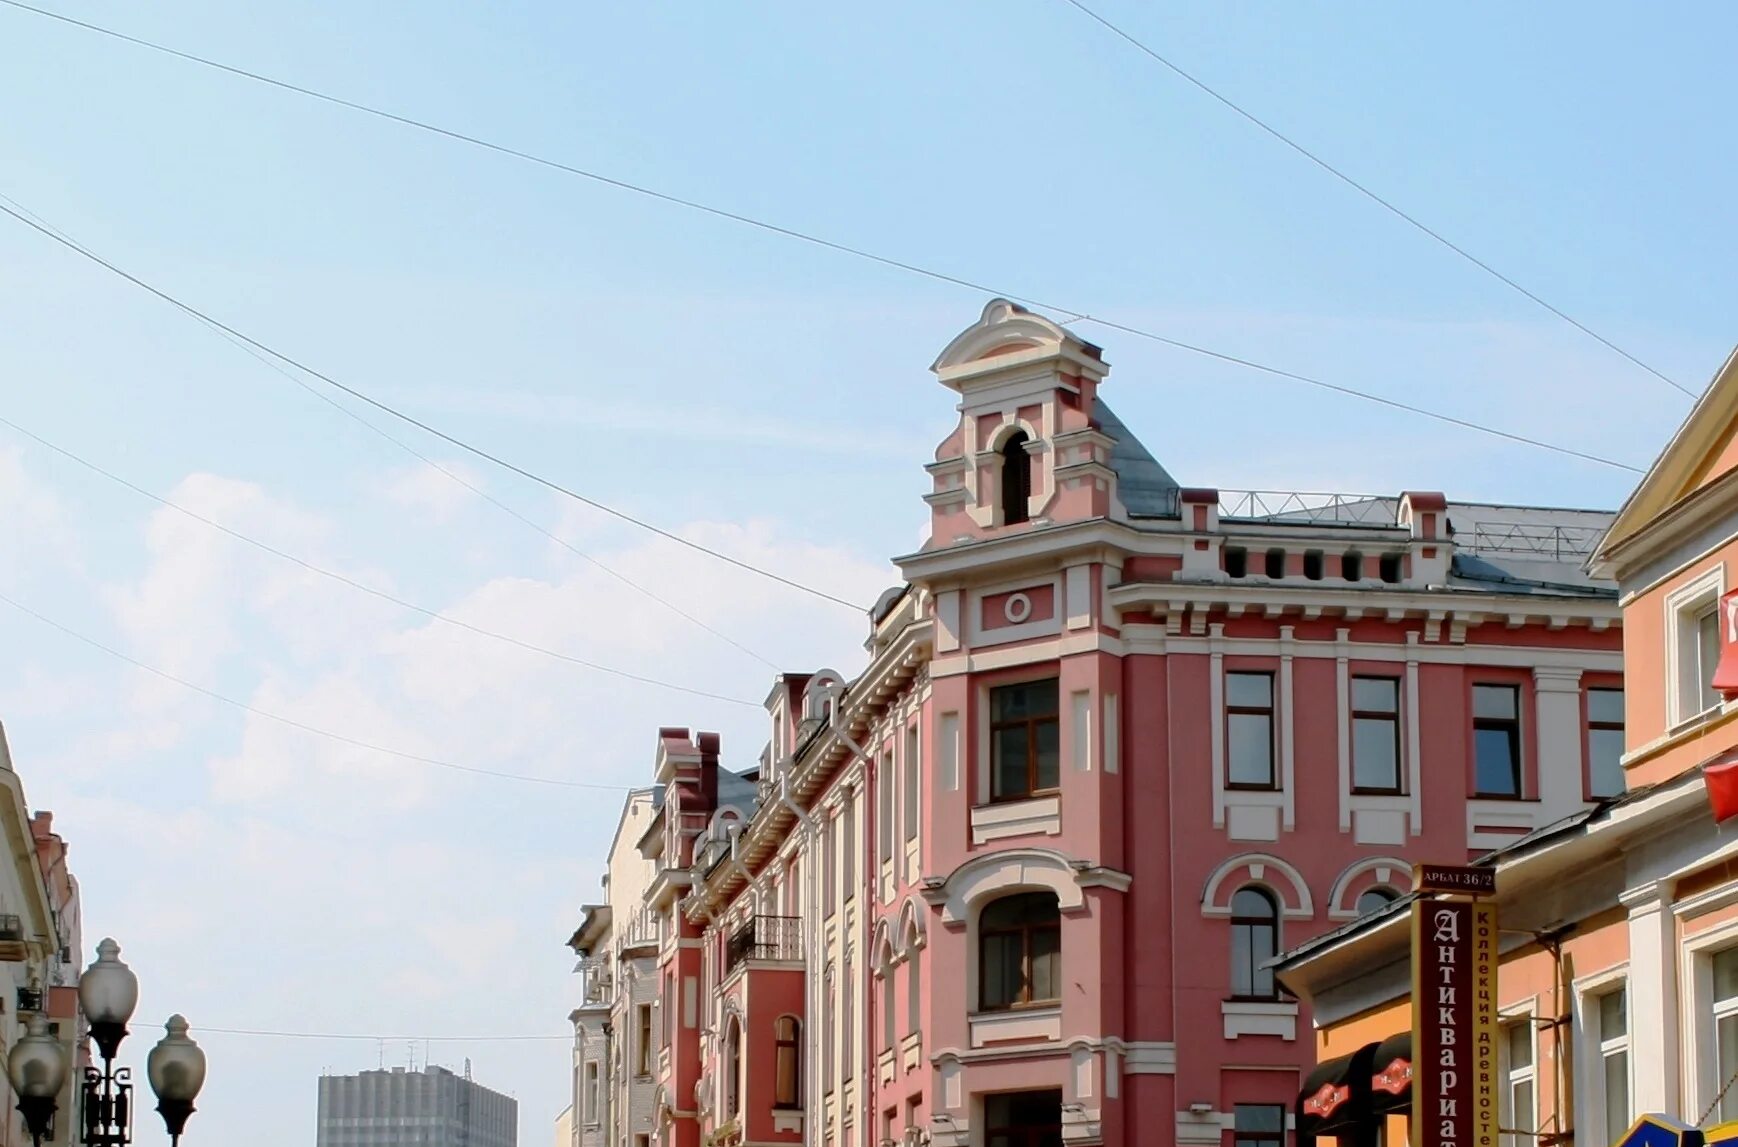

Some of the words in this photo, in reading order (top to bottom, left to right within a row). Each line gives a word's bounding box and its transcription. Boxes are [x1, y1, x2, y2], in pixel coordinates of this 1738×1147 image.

[1424, 872, 1460, 883] АРБАТ
[1463, 873, 1493, 886] 36/2
[1478, 912, 1490, 1025] Коллекция
